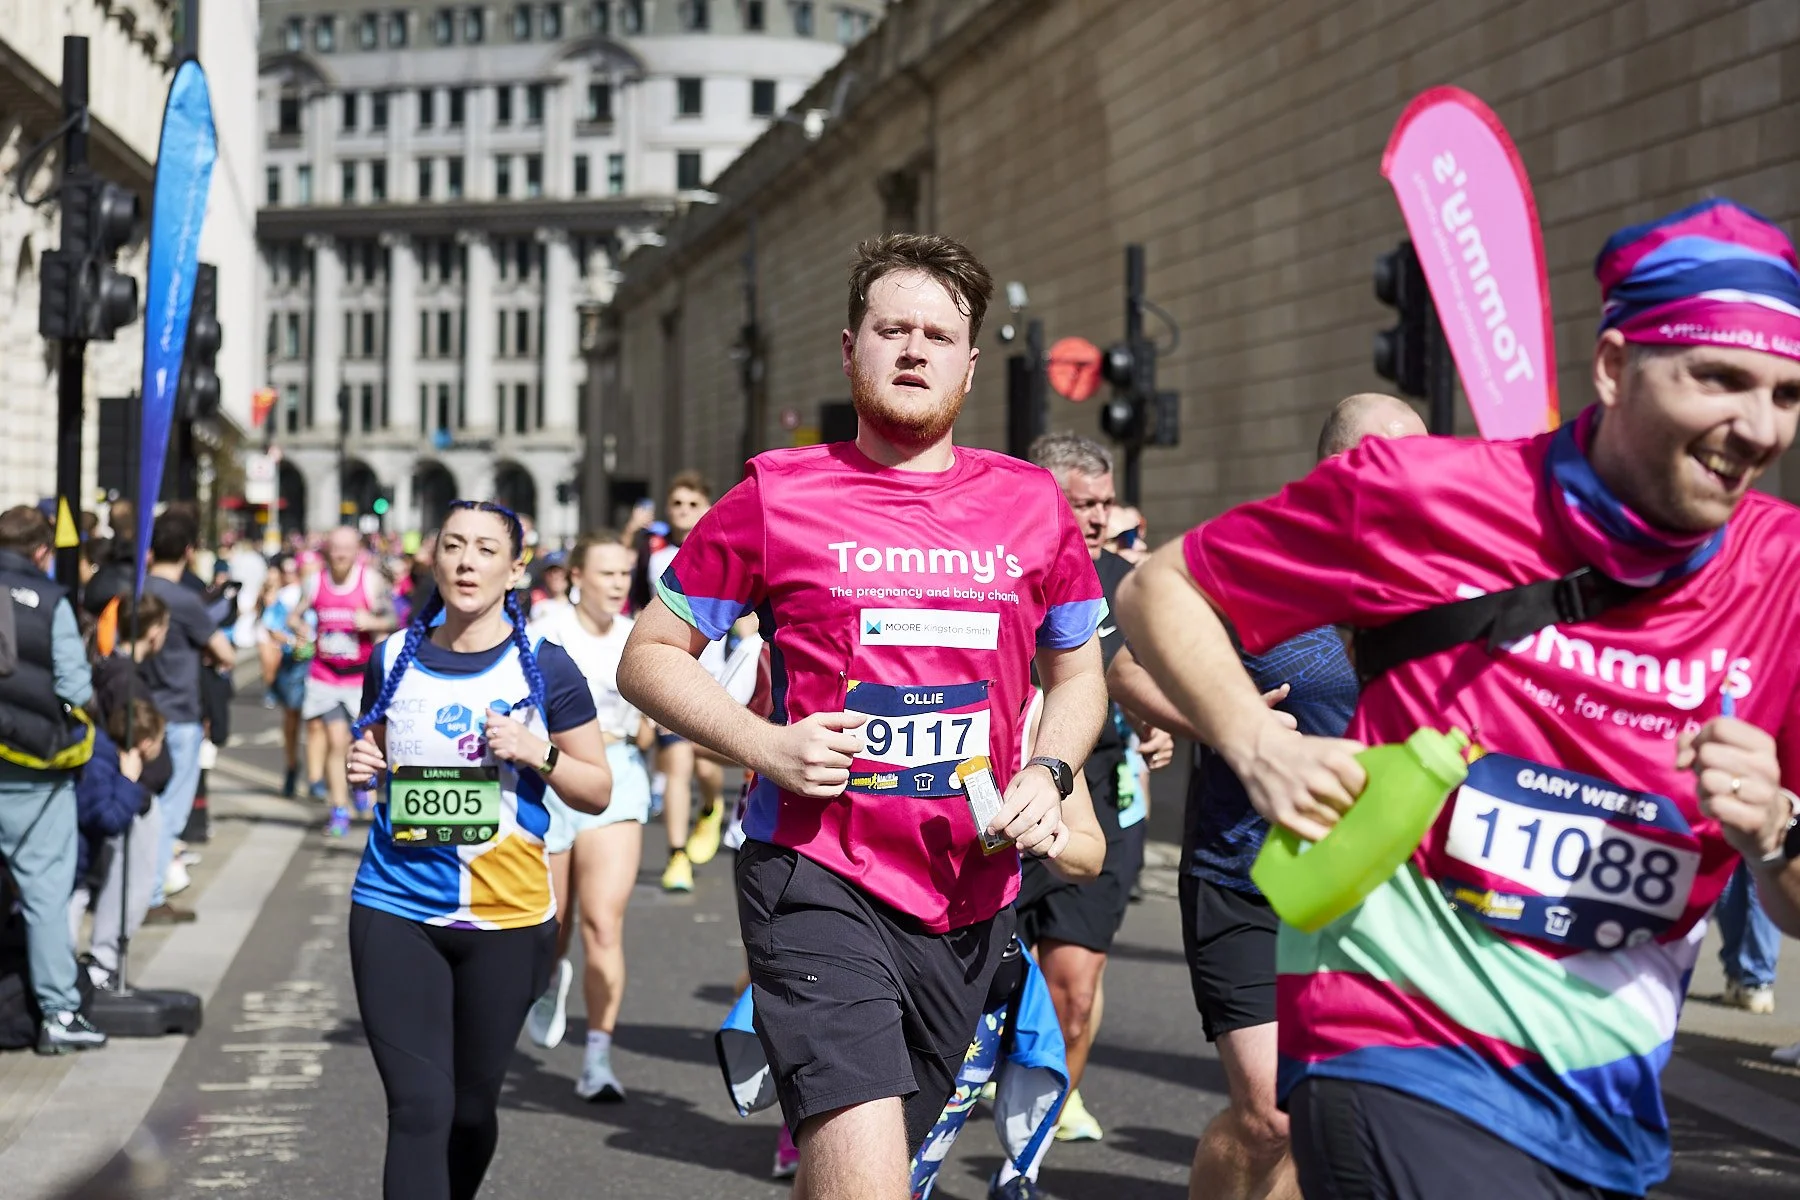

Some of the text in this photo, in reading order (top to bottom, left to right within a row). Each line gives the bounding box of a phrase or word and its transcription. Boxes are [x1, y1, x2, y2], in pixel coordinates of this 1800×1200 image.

[827, 541, 1024, 584] Tommy's
[829, 586, 853, 598] The
[856, 587, 923, 599] pregnancy
[926, 587, 950, 598] and
[953, 587, 985, 602] baby
[885, 623, 991, 635] MOORE Kingston Smith
[1456, 583, 1752, 710] mmy's
[903, 692, 944, 705] OLLIE
[1573, 692, 1608, 721] for
[1612, 708, 1679, 740] every
[866, 717, 973, 757] 9117
[423, 769, 461, 779] LIANNE
[404, 789, 483, 816] 6805
[1516, 768, 1659, 822] GARY WEEKS
[1476, 807, 1679, 906] 11088
